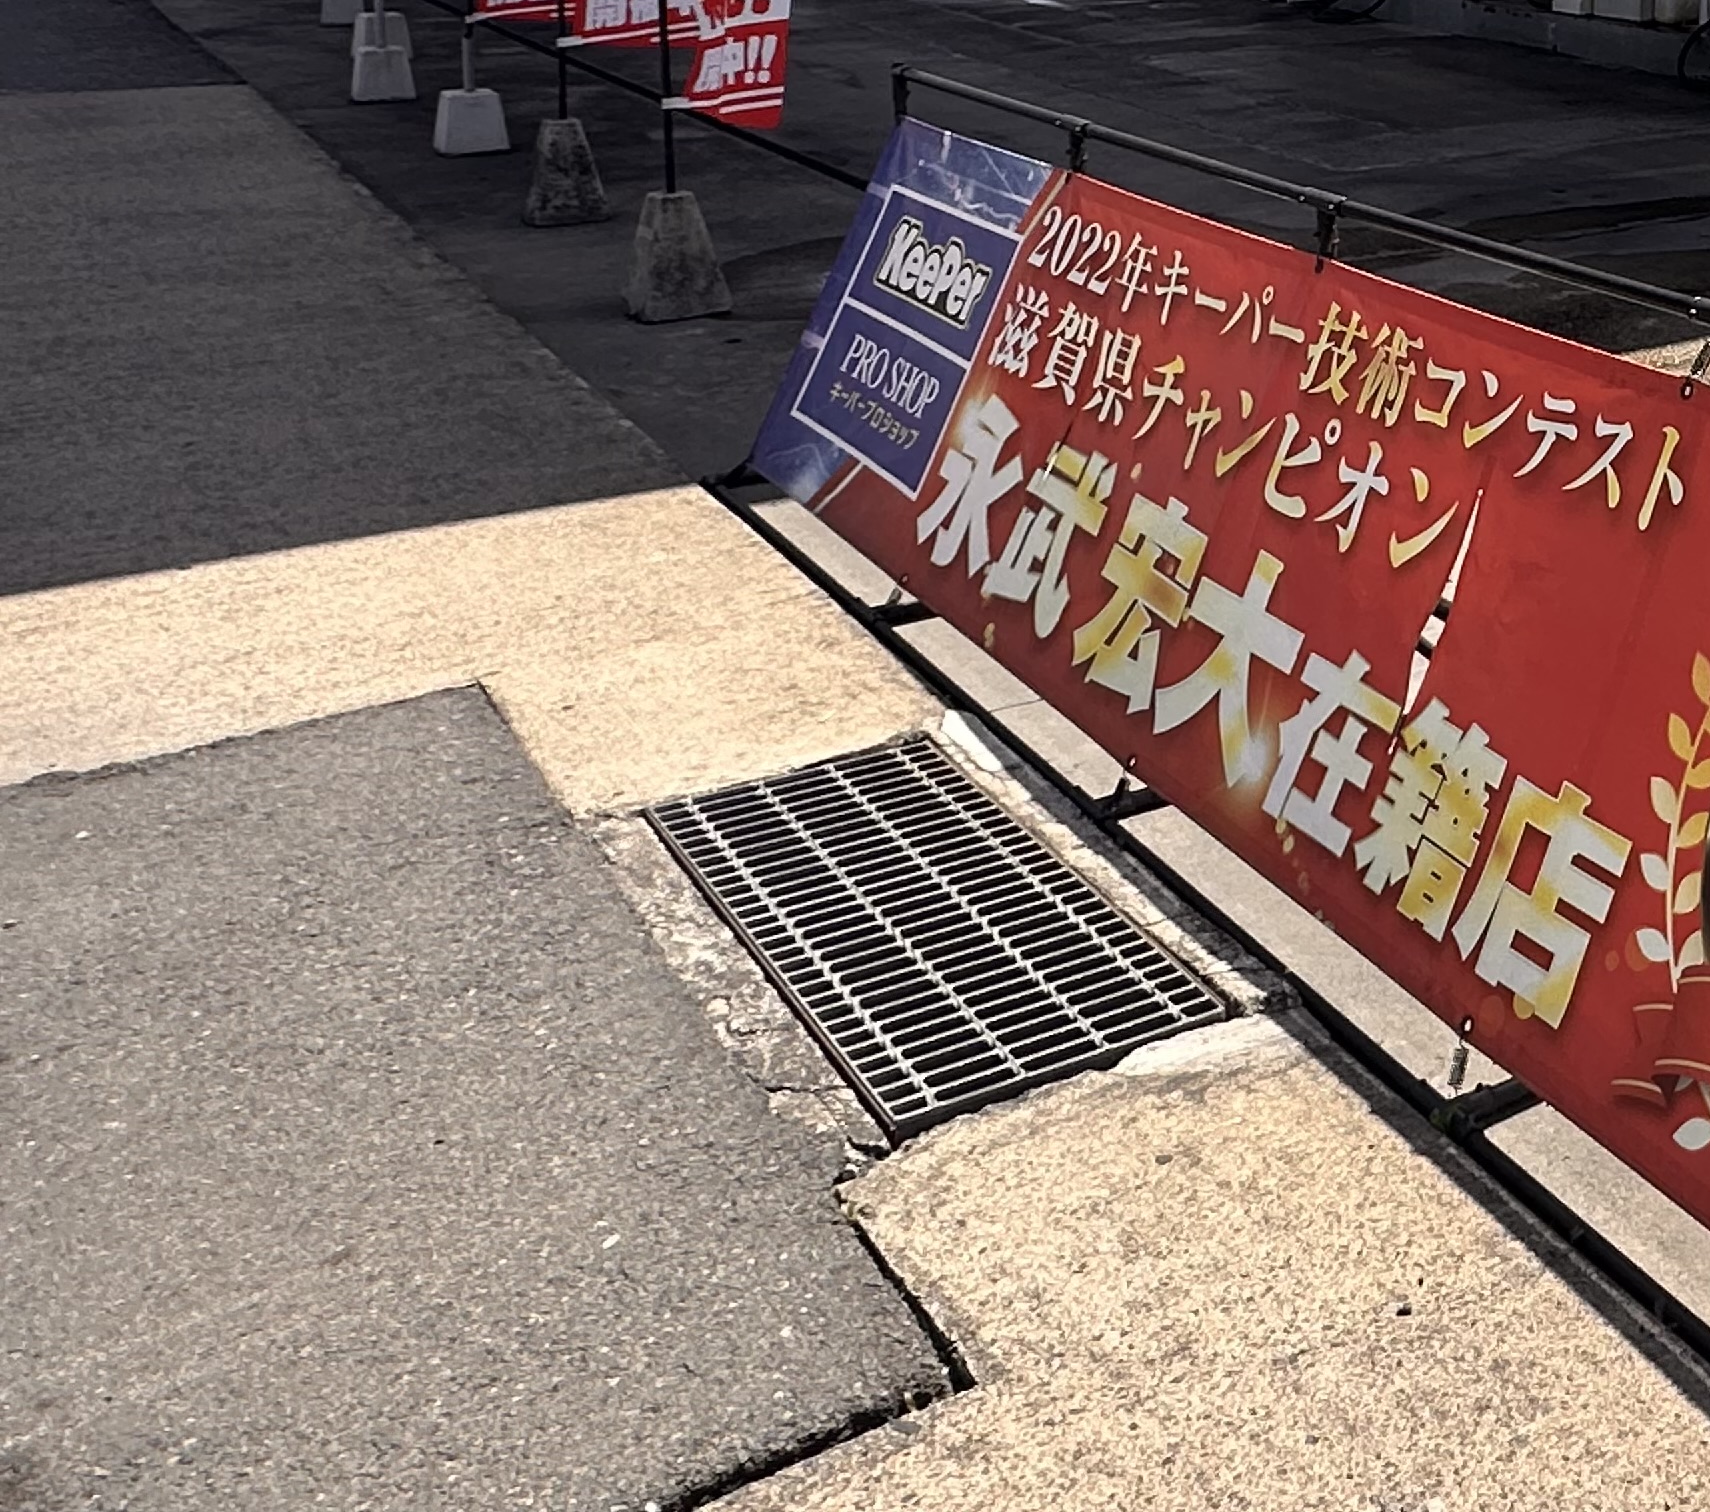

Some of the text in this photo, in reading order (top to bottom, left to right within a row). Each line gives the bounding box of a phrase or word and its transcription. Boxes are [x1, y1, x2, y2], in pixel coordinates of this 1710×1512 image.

[876, 218, 991, 327] KeePer
[828, 381, 921, 451] キーパープロショップ
[839, 333, 941, 421] PRO SHOP
[1026, 205, 1686, 531] 2022年キーパー技術コンテスト
[985, 281, 1460, 569] 滋賀県チャンピオン
